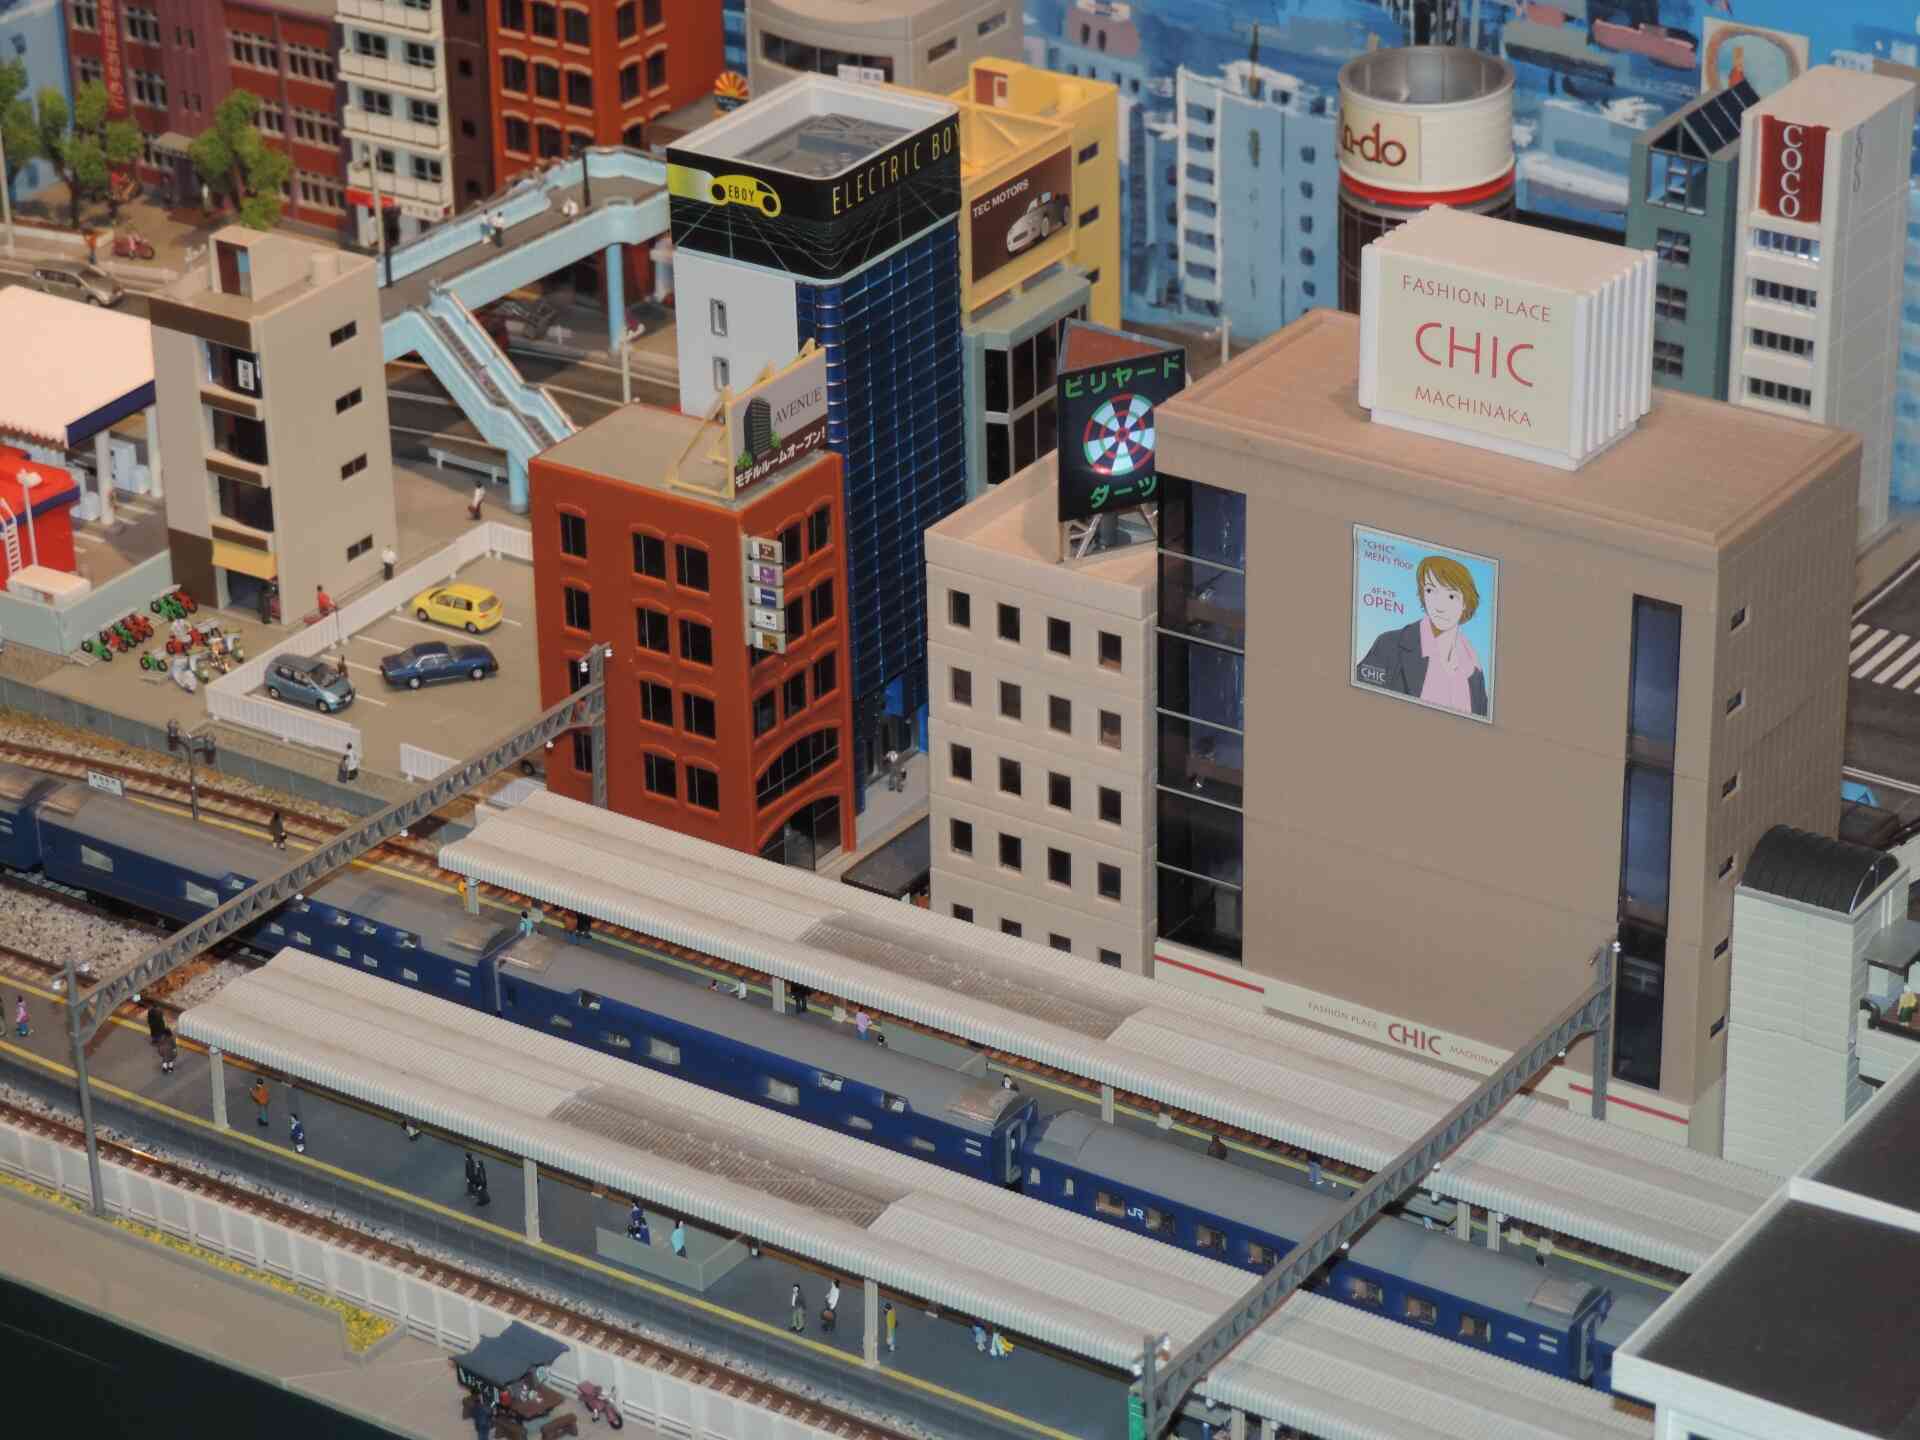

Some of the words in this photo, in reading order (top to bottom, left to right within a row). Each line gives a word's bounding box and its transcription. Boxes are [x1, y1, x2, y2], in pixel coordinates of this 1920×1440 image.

[832, 141, 921, 216] ELECTRIC
[1779, 125, 1803, 218] COCO
[728, 184, 754, 202] EBOY
[972, 200, 991, 218] TEC
[991, 178, 1030, 209] MOTORS
[1402, 274, 1487, 308] FASHION
[1494, 295, 1552, 322] PLACE
[1415, 321, 1535, 388] CHIC
[1064, 354, 1180, 399] ビリヤード
[774, 386, 824, 424] AVENUE
[1415, 385, 1532, 427] MACHINAKA
[1090, 474, 1158, 509] ダーツ
[1363, 593, 1405, 615] OPEN
[1361, 667, 1385, 682] CHIC
[1308, 1001, 1349, 1021] FASHION
[1387, 1023, 1442, 1056] CHIC
[1127, 1207, 1144, 1220] JR
